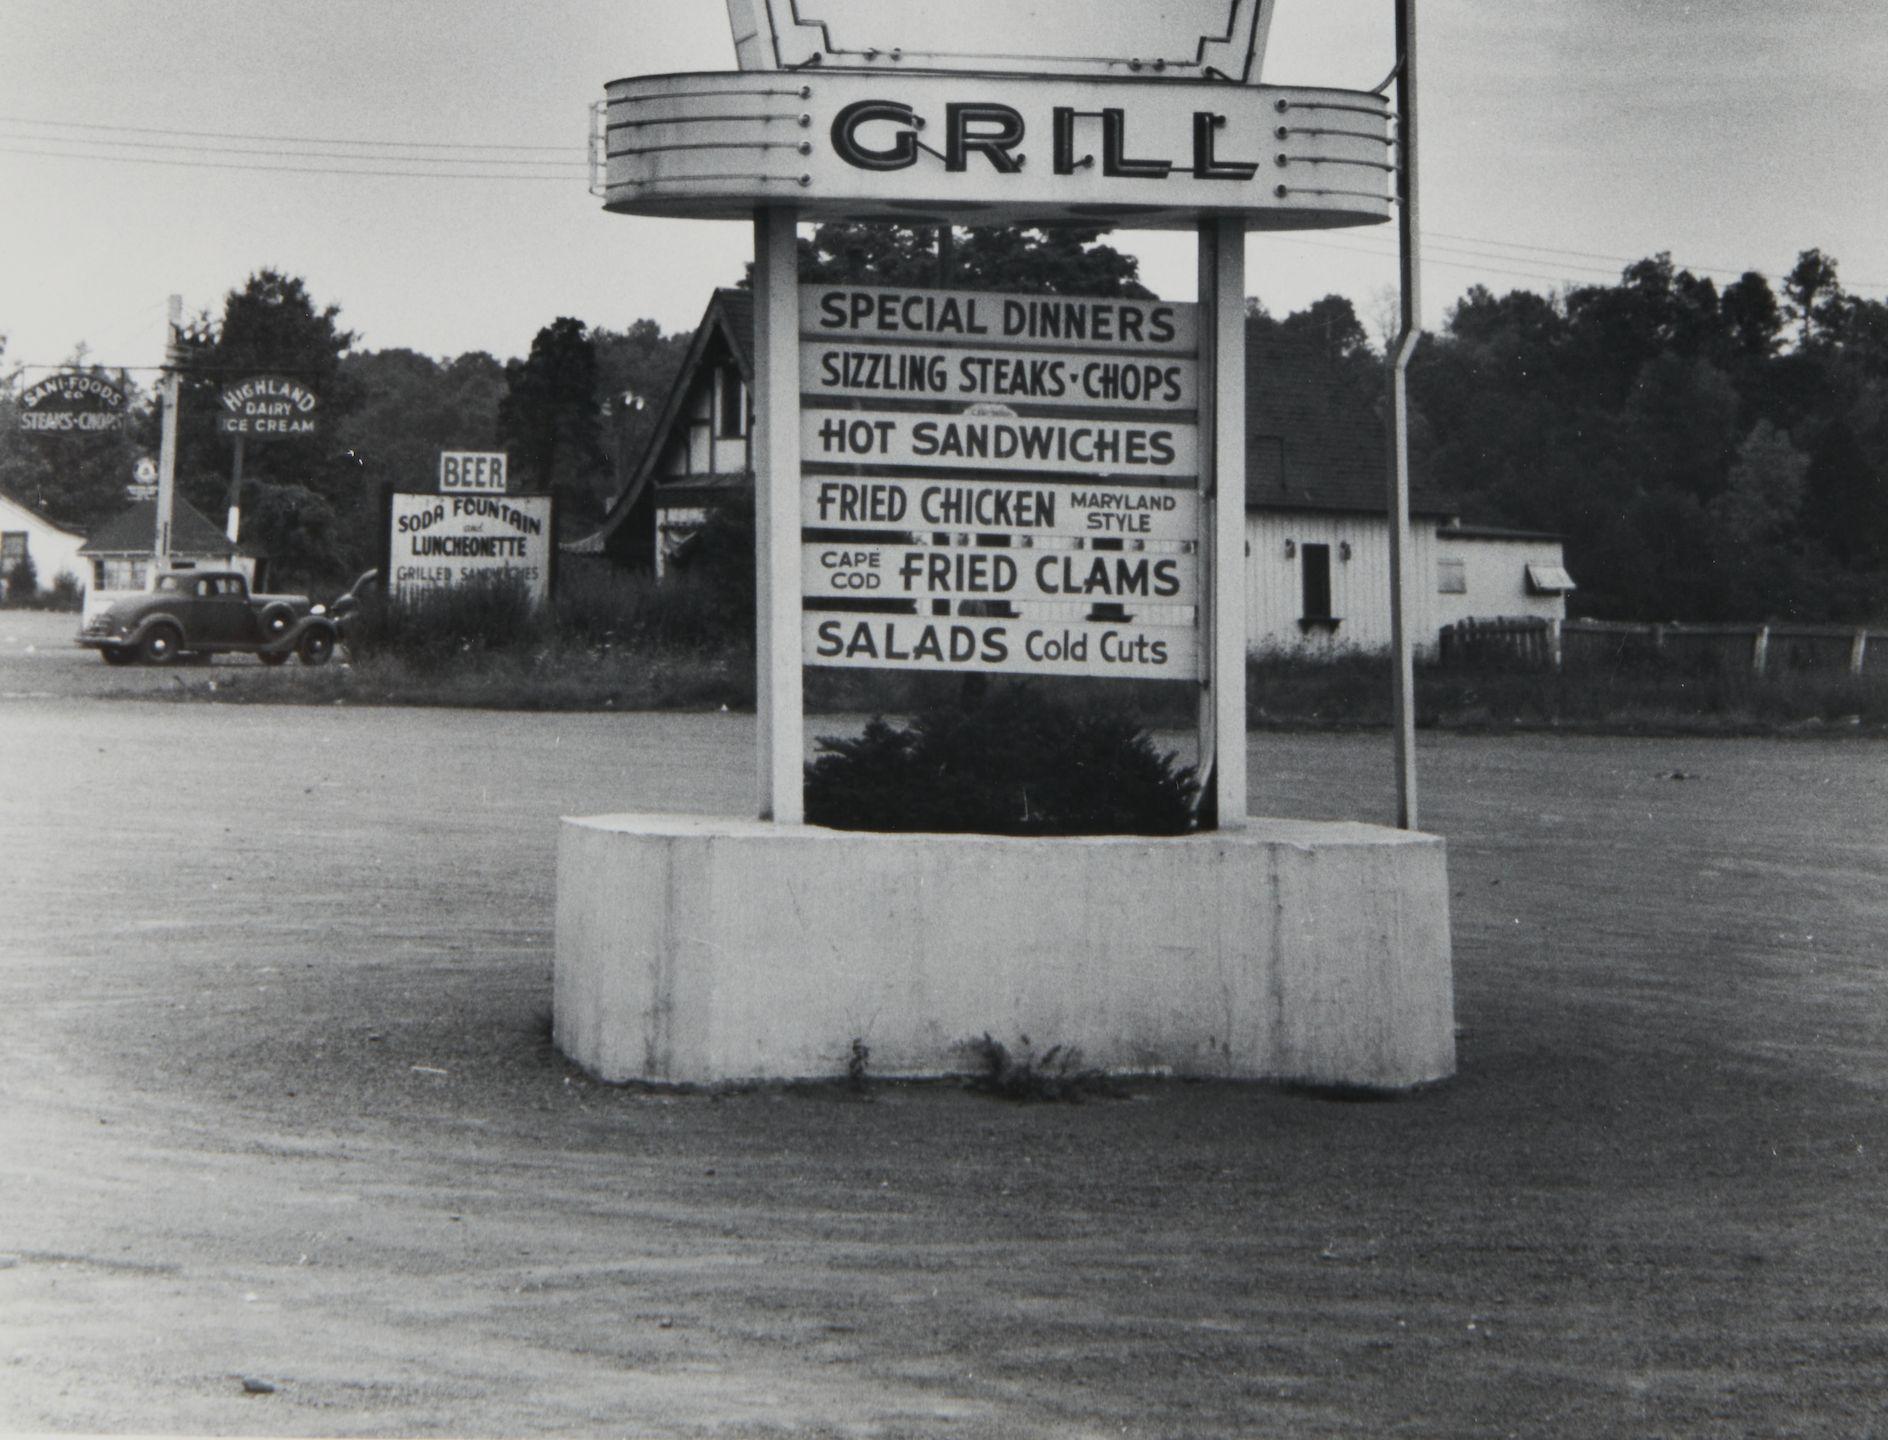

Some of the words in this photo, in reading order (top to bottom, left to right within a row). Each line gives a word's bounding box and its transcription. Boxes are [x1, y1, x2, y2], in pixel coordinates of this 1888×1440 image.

[830, 99, 1260, 180] GRILL
[820, 291, 988, 334] SPECIAL
[1003, 300, 1176, 343] DINNERS
[821, 351, 947, 392] SIZZLING
[223, 380, 316, 412] HIGHLAND
[245, 401, 292, 415] DAIRY
[255, 419, 315, 432] CREAM
[818, 419, 896, 454] HOT
[911, 422, 1176, 465] SANDWICHES
[444, 457, 504, 488] BEER
[399, 505, 445, 533] SODA
[453, 497, 542, 536] FOUNTAIN
[817, 483, 907, 522] FRIED
[920, 486, 1056, 528] CHICKEN
[1070, 492, 1177, 512] MARYLAND
[1087, 513, 1152, 533] STYLE
[412, 536, 527, 557] LUNCHEONETTE
[820, 551, 881, 569] CAPE
[831, 573, 882, 590] COD
[899, 553, 1018, 592] FRIED
[1035, 556, 1181, 596] CLAMS
[816, 621, 1009, 663] SALADS
[1025, 630, 1088, 661] Cold
[1100, 631, 1168, 664] Cuts
